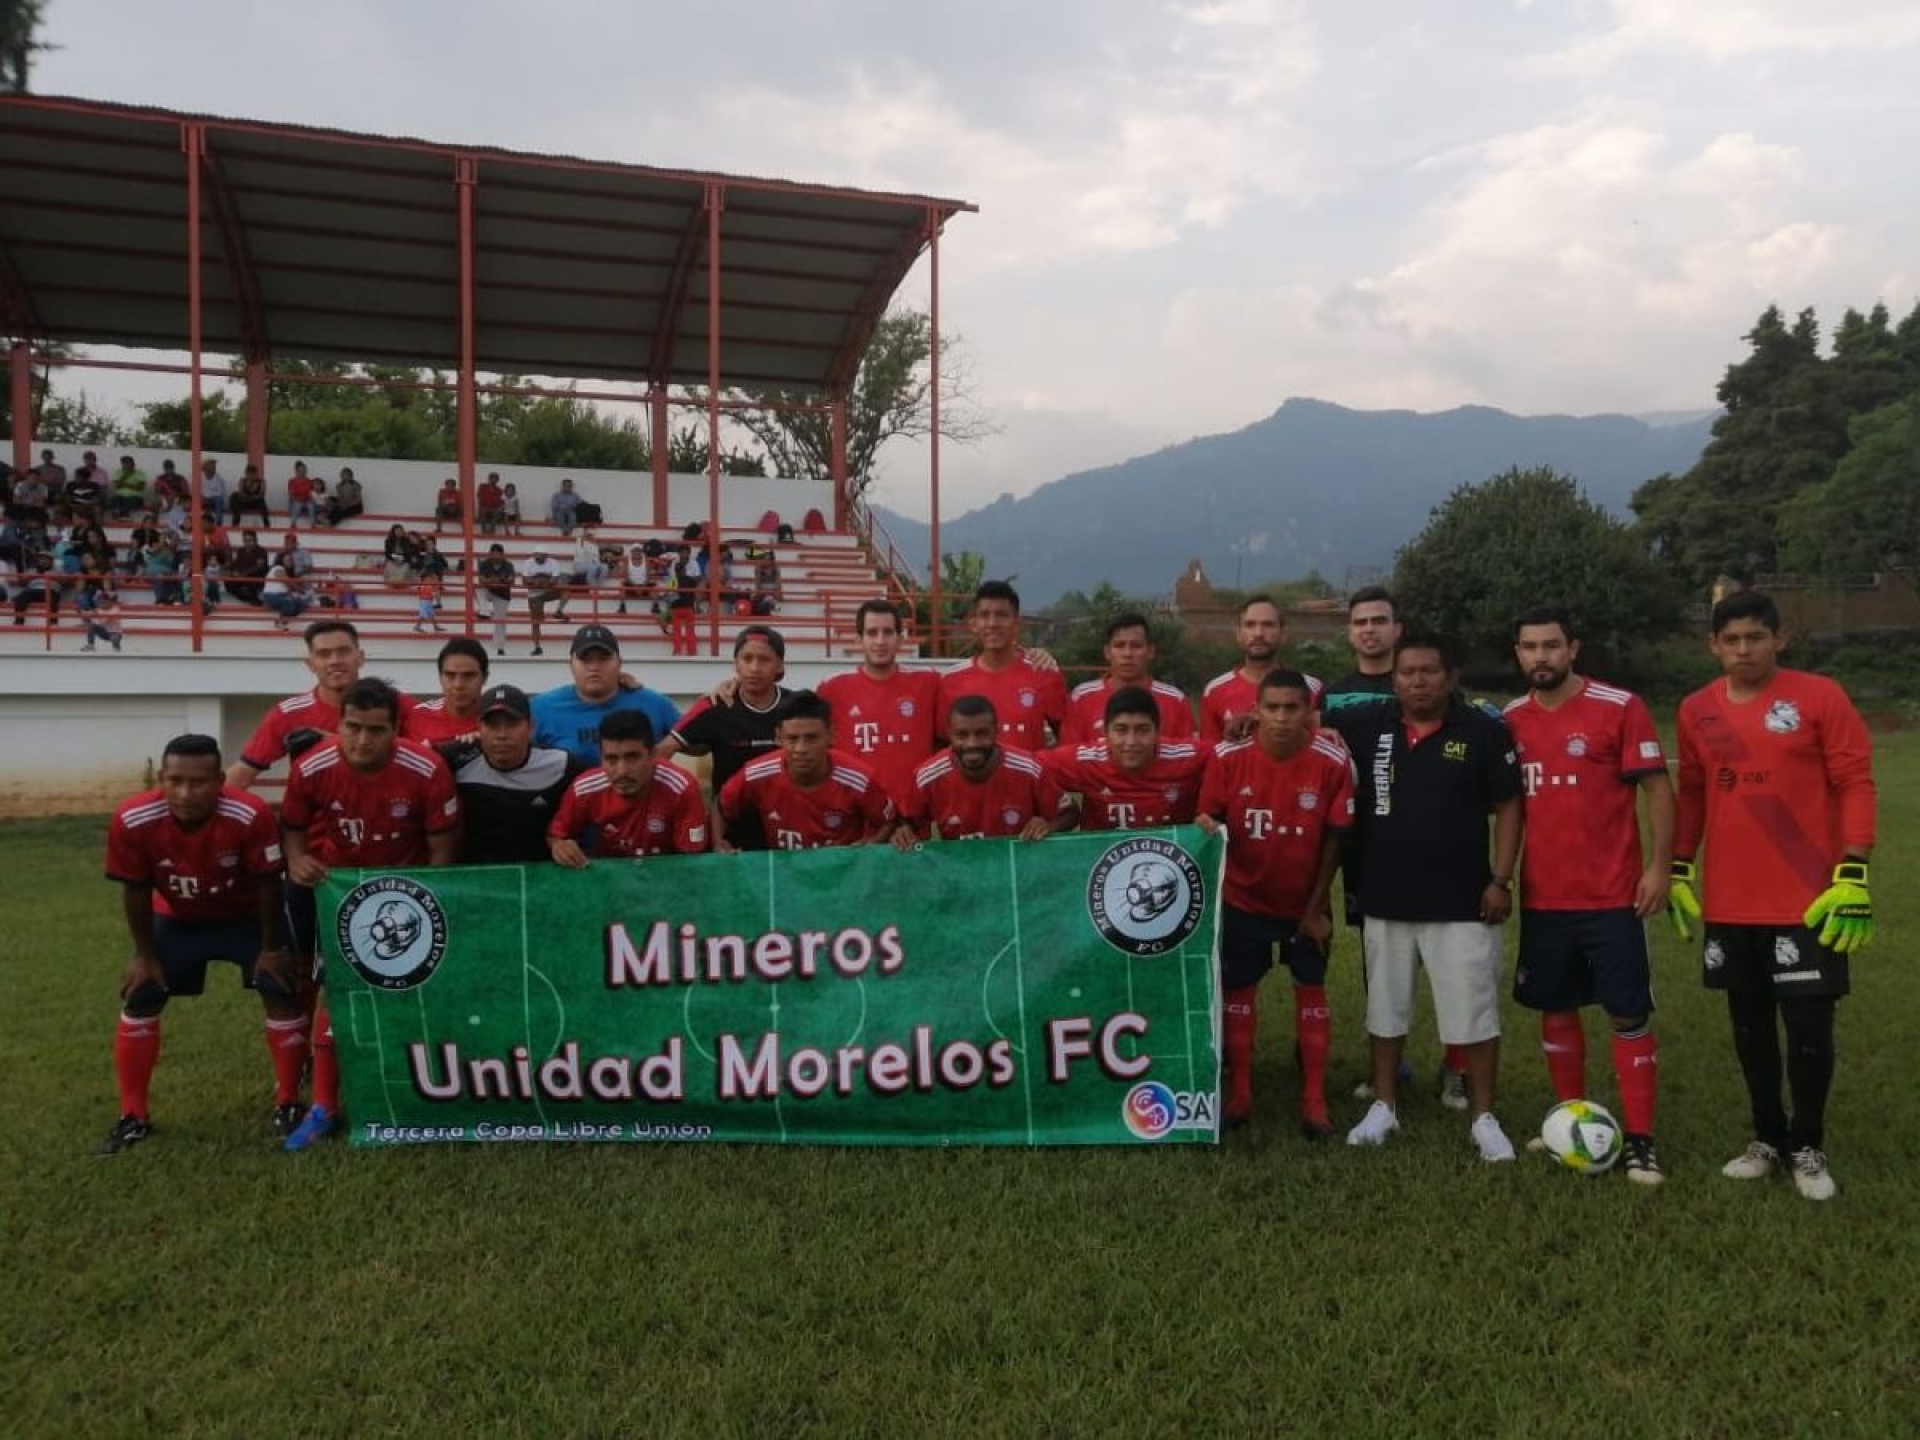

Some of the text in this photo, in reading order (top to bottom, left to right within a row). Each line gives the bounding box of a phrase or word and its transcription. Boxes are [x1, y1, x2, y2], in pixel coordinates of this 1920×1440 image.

[1373, 733, 1394, 815] CATERPILLAR
[1444, 741, 1468, 756] CAT
[1106, 840, 1175, 863] Unidad
[1177, 855, 1203, 930] Morelos
[609, 921, 904, 986] Mineros
[410, 1012, 1150, 1099] Unidad Morelos FC
[366, 1122, 465, 1140] Tercera
[554, 1119, 623, 1137] Libre
[1176, 1095, 1217, 1121] SA
